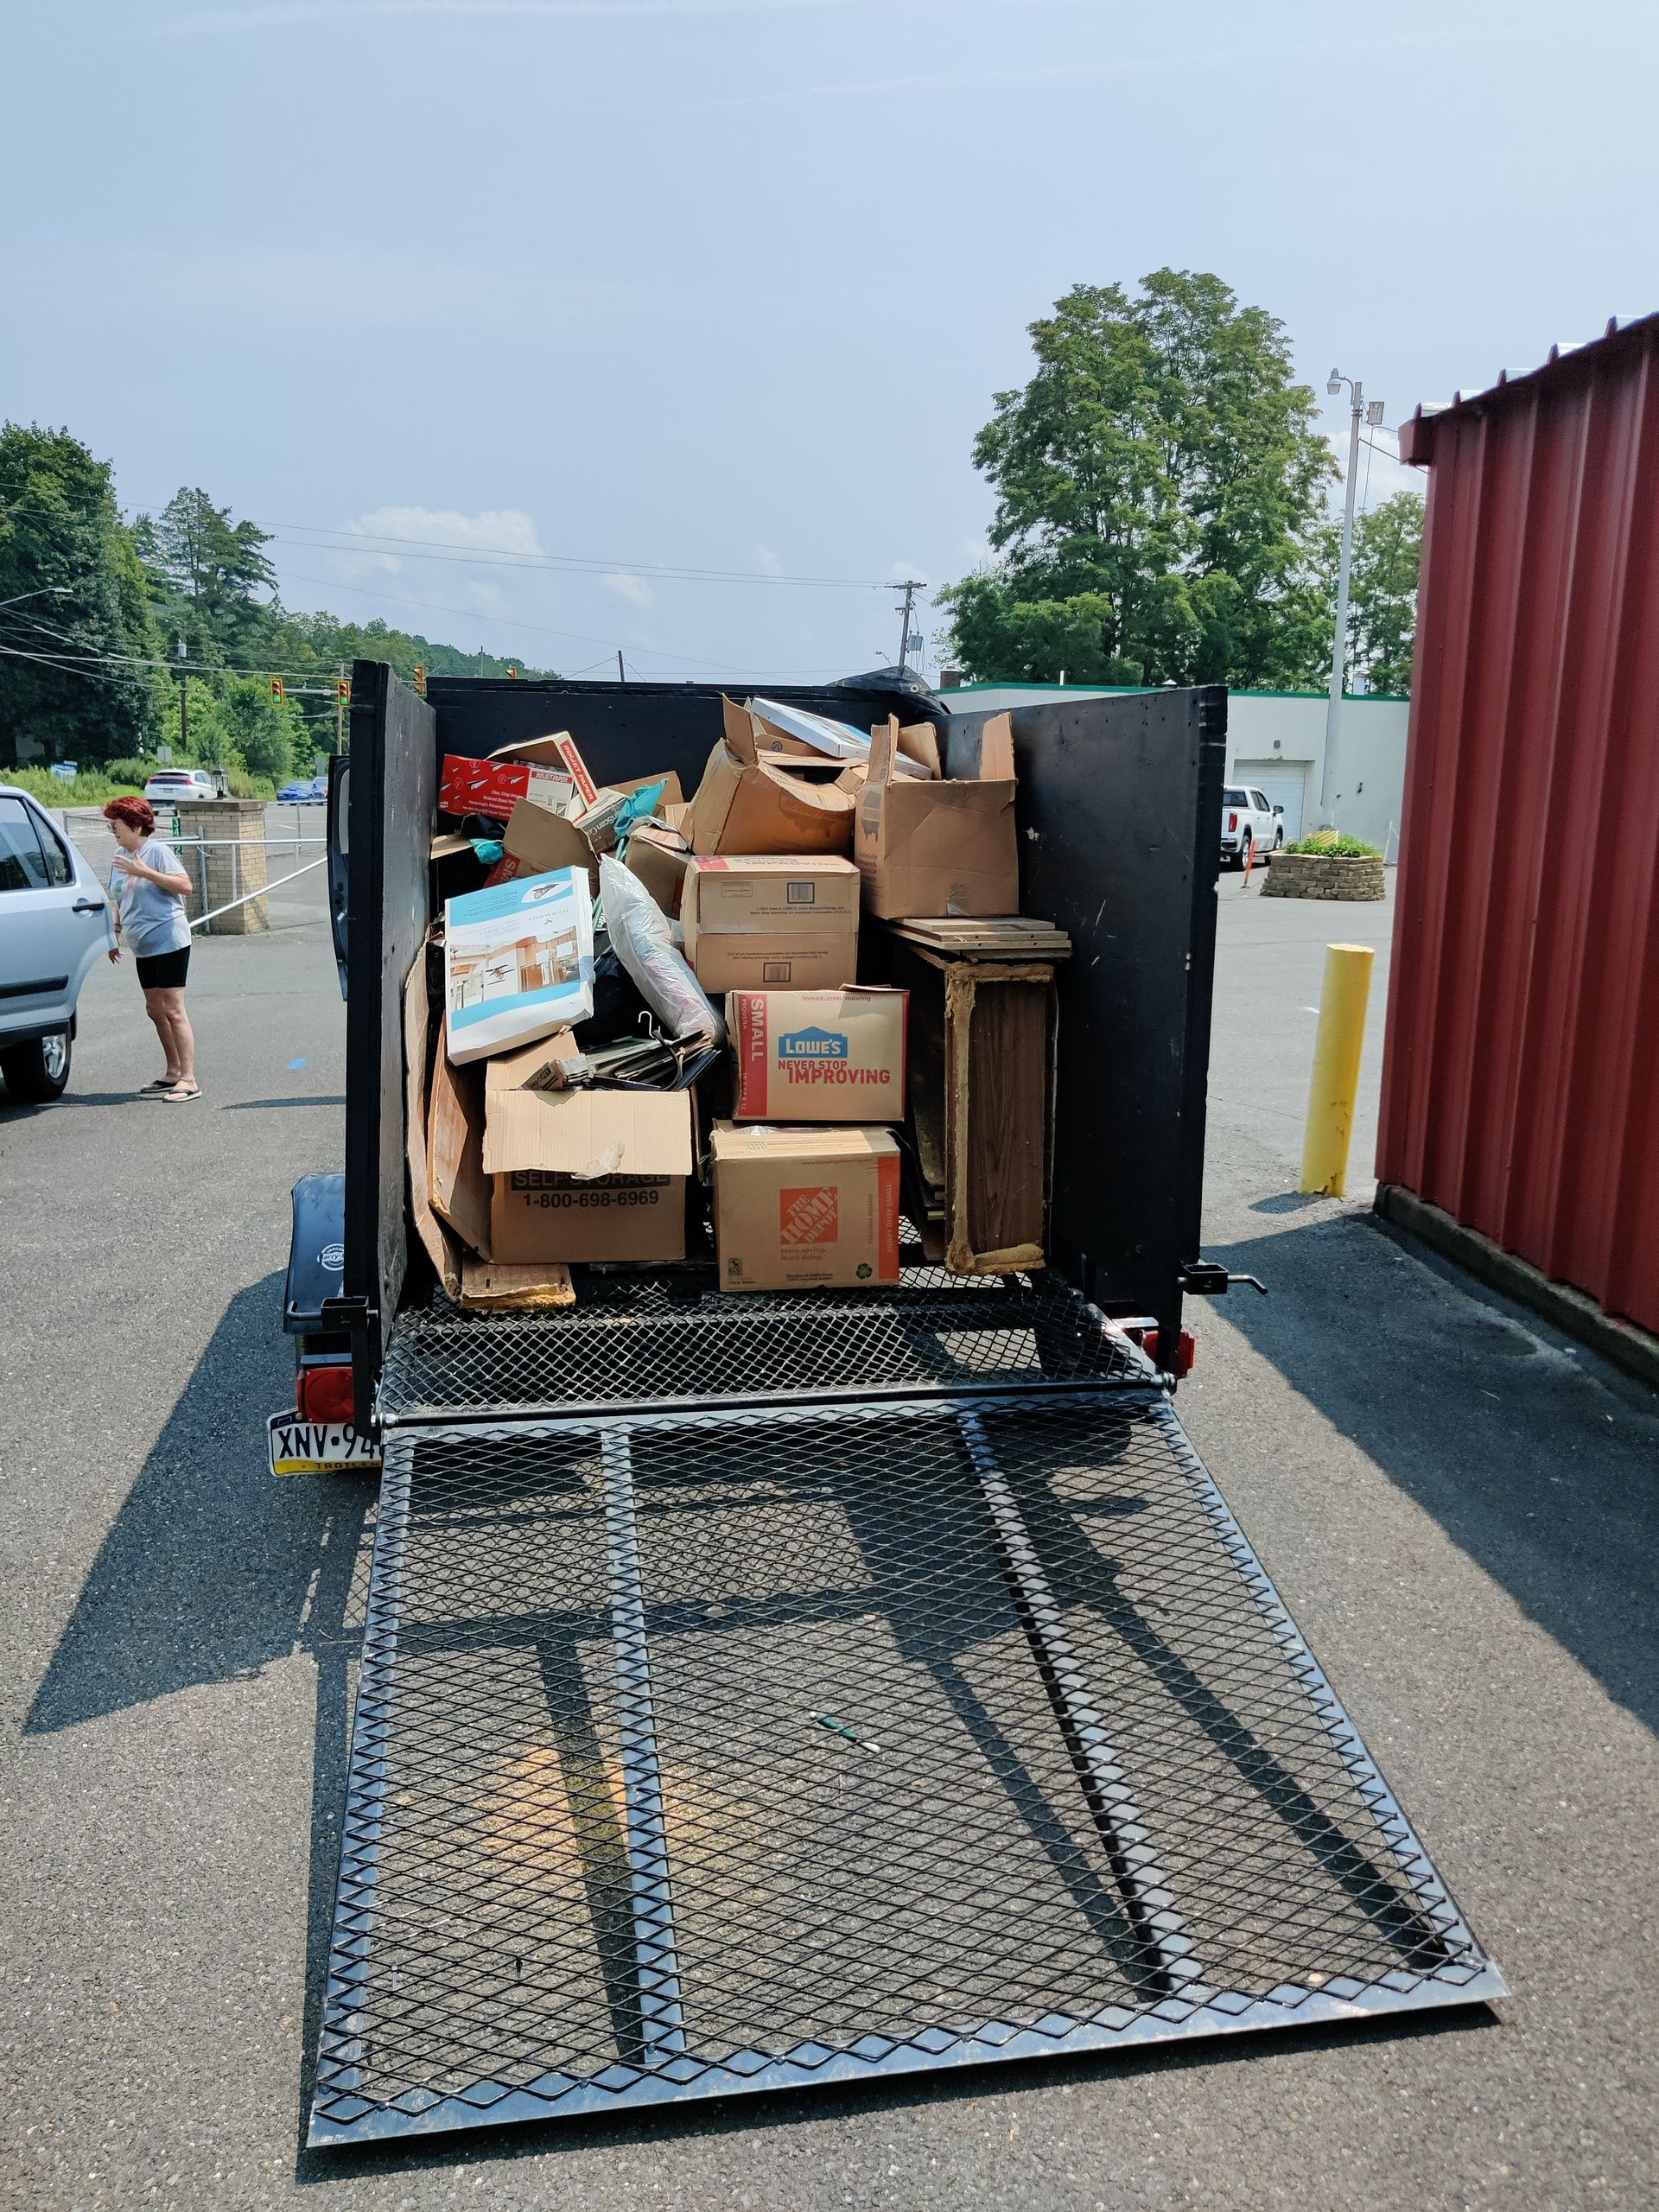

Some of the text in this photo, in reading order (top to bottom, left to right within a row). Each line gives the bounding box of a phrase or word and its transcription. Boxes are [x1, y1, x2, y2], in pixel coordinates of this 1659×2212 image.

[536, 772, 569, 784] INKJET PAPER
[563, 745, 594, 800] INKJET PAPER
[751, 998, 765, 1062] SMALL
[785, 1038, 842, 1055] LOWE'S
[778, 1060, 848, 1071] NEVER STOP
[523, 1190, 659, 1209] 1-800-698-6969
[787, 1194, 810, 1217] THE
[781, 1187, 837, 1244] HOME
[803, 1206, 837, 1244] DEPOT
[342, 1422, 383, 1459] 94
